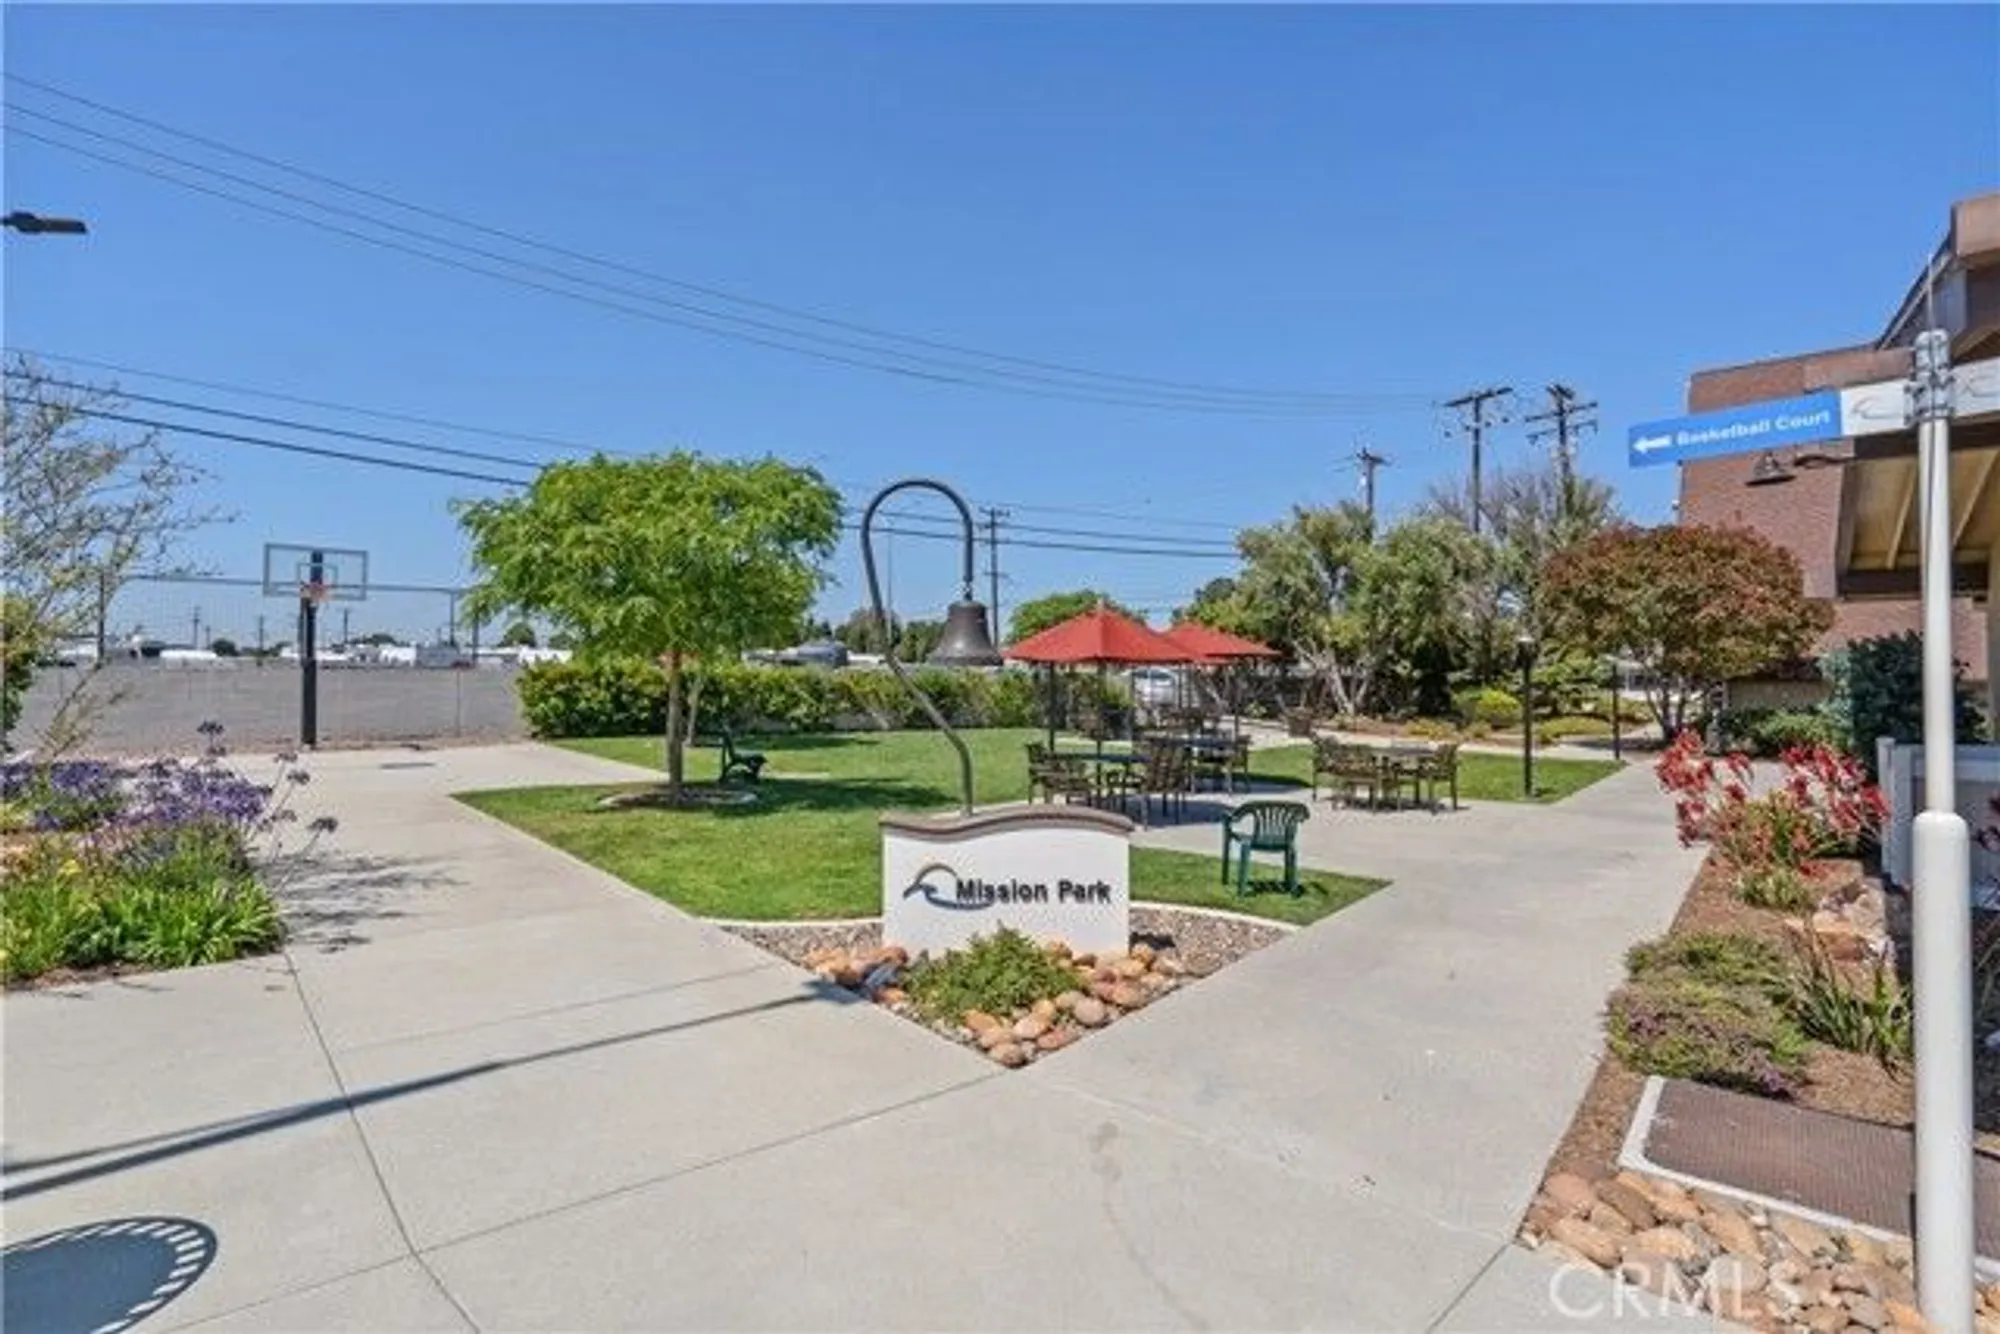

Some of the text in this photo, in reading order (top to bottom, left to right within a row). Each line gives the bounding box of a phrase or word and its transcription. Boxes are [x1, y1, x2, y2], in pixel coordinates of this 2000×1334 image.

[1676, 409, 1831, 446] Basketball Court
[956, 878, 1112, 903] Mission Park
